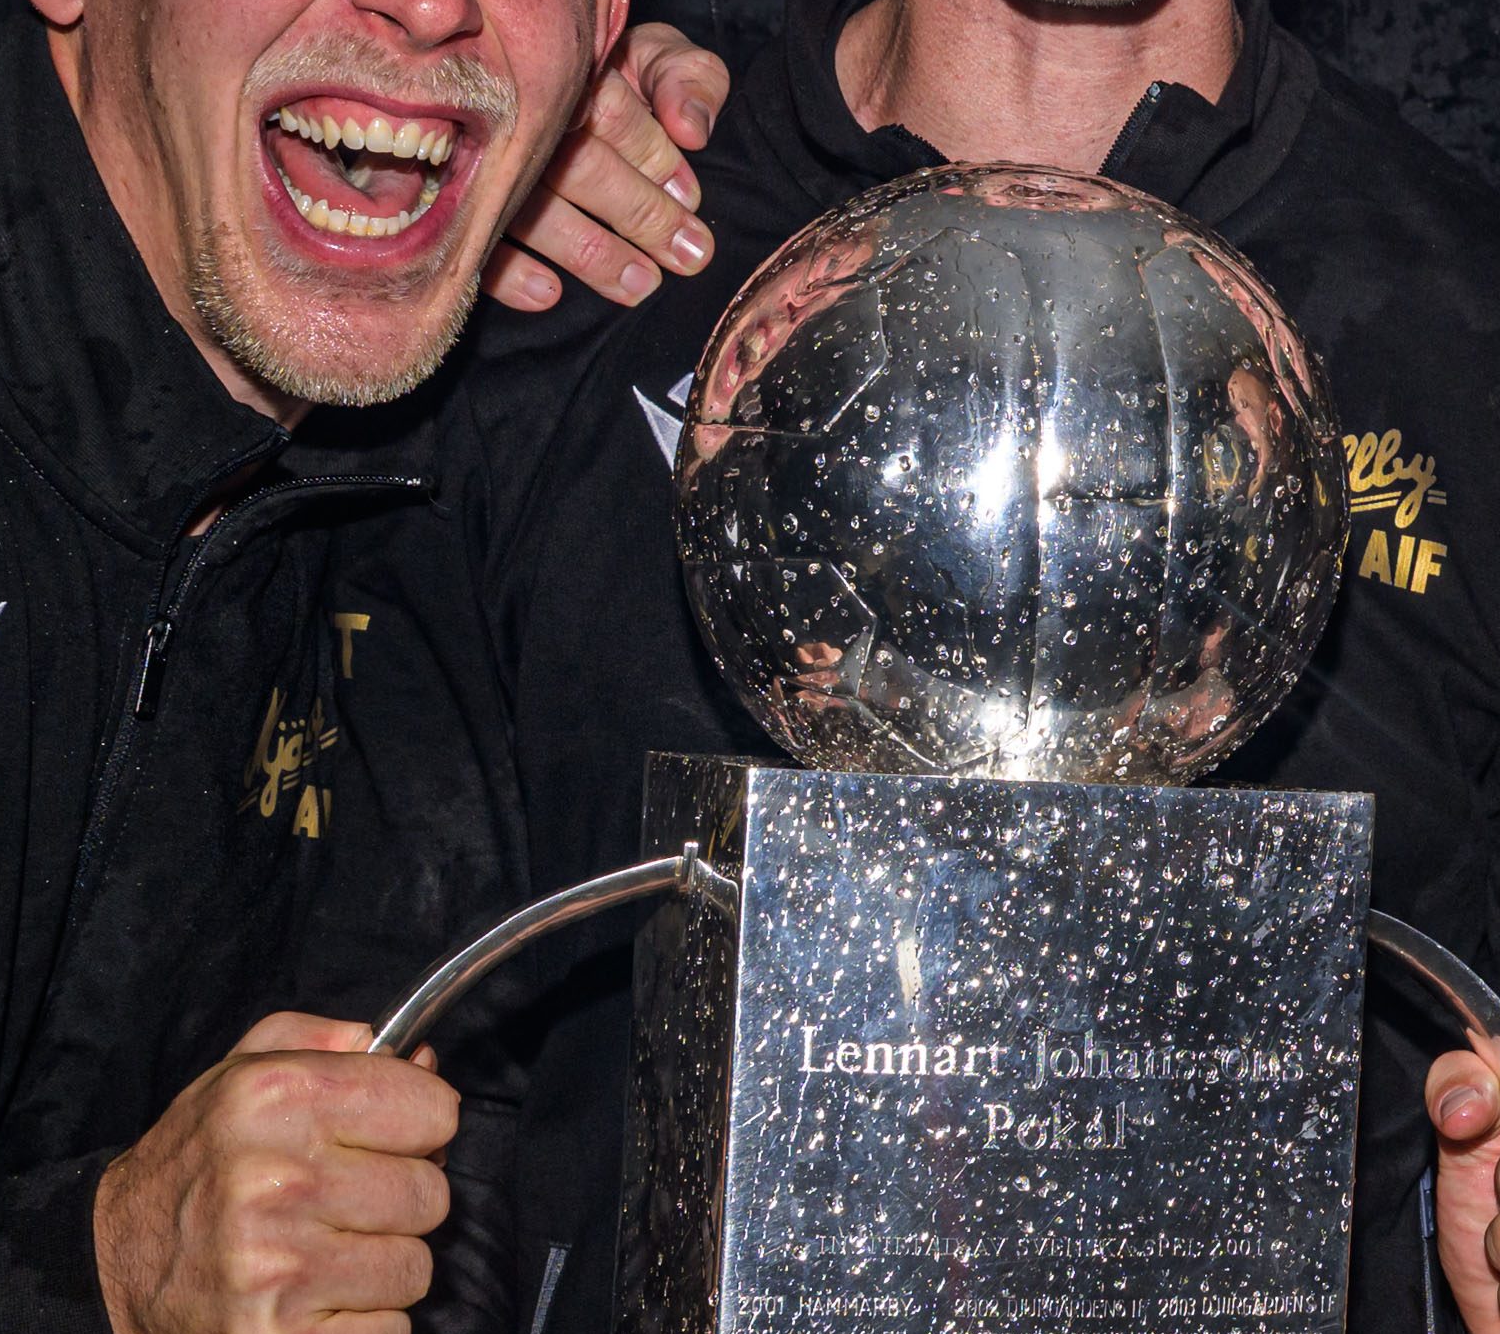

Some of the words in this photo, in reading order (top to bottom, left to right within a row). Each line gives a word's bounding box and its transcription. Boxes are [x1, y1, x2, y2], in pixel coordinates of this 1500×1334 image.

[1358, 528, 1448, 595] AIF
[797, 1025, 1009, 1077] Lennart
[1023, 1028, 1304, 1092] Johanssons
[983, 1100, 1127, 1150] Pokal
[1208, 1237, 1263, 1258] 2001
[737, 1295, 785, 1317] 2001
[799, 1294, 915, 1317] HAMMARBY
[1157, 1297, 1197, 1317] 2003
[1320, 1294, 1338, 1314] IF
